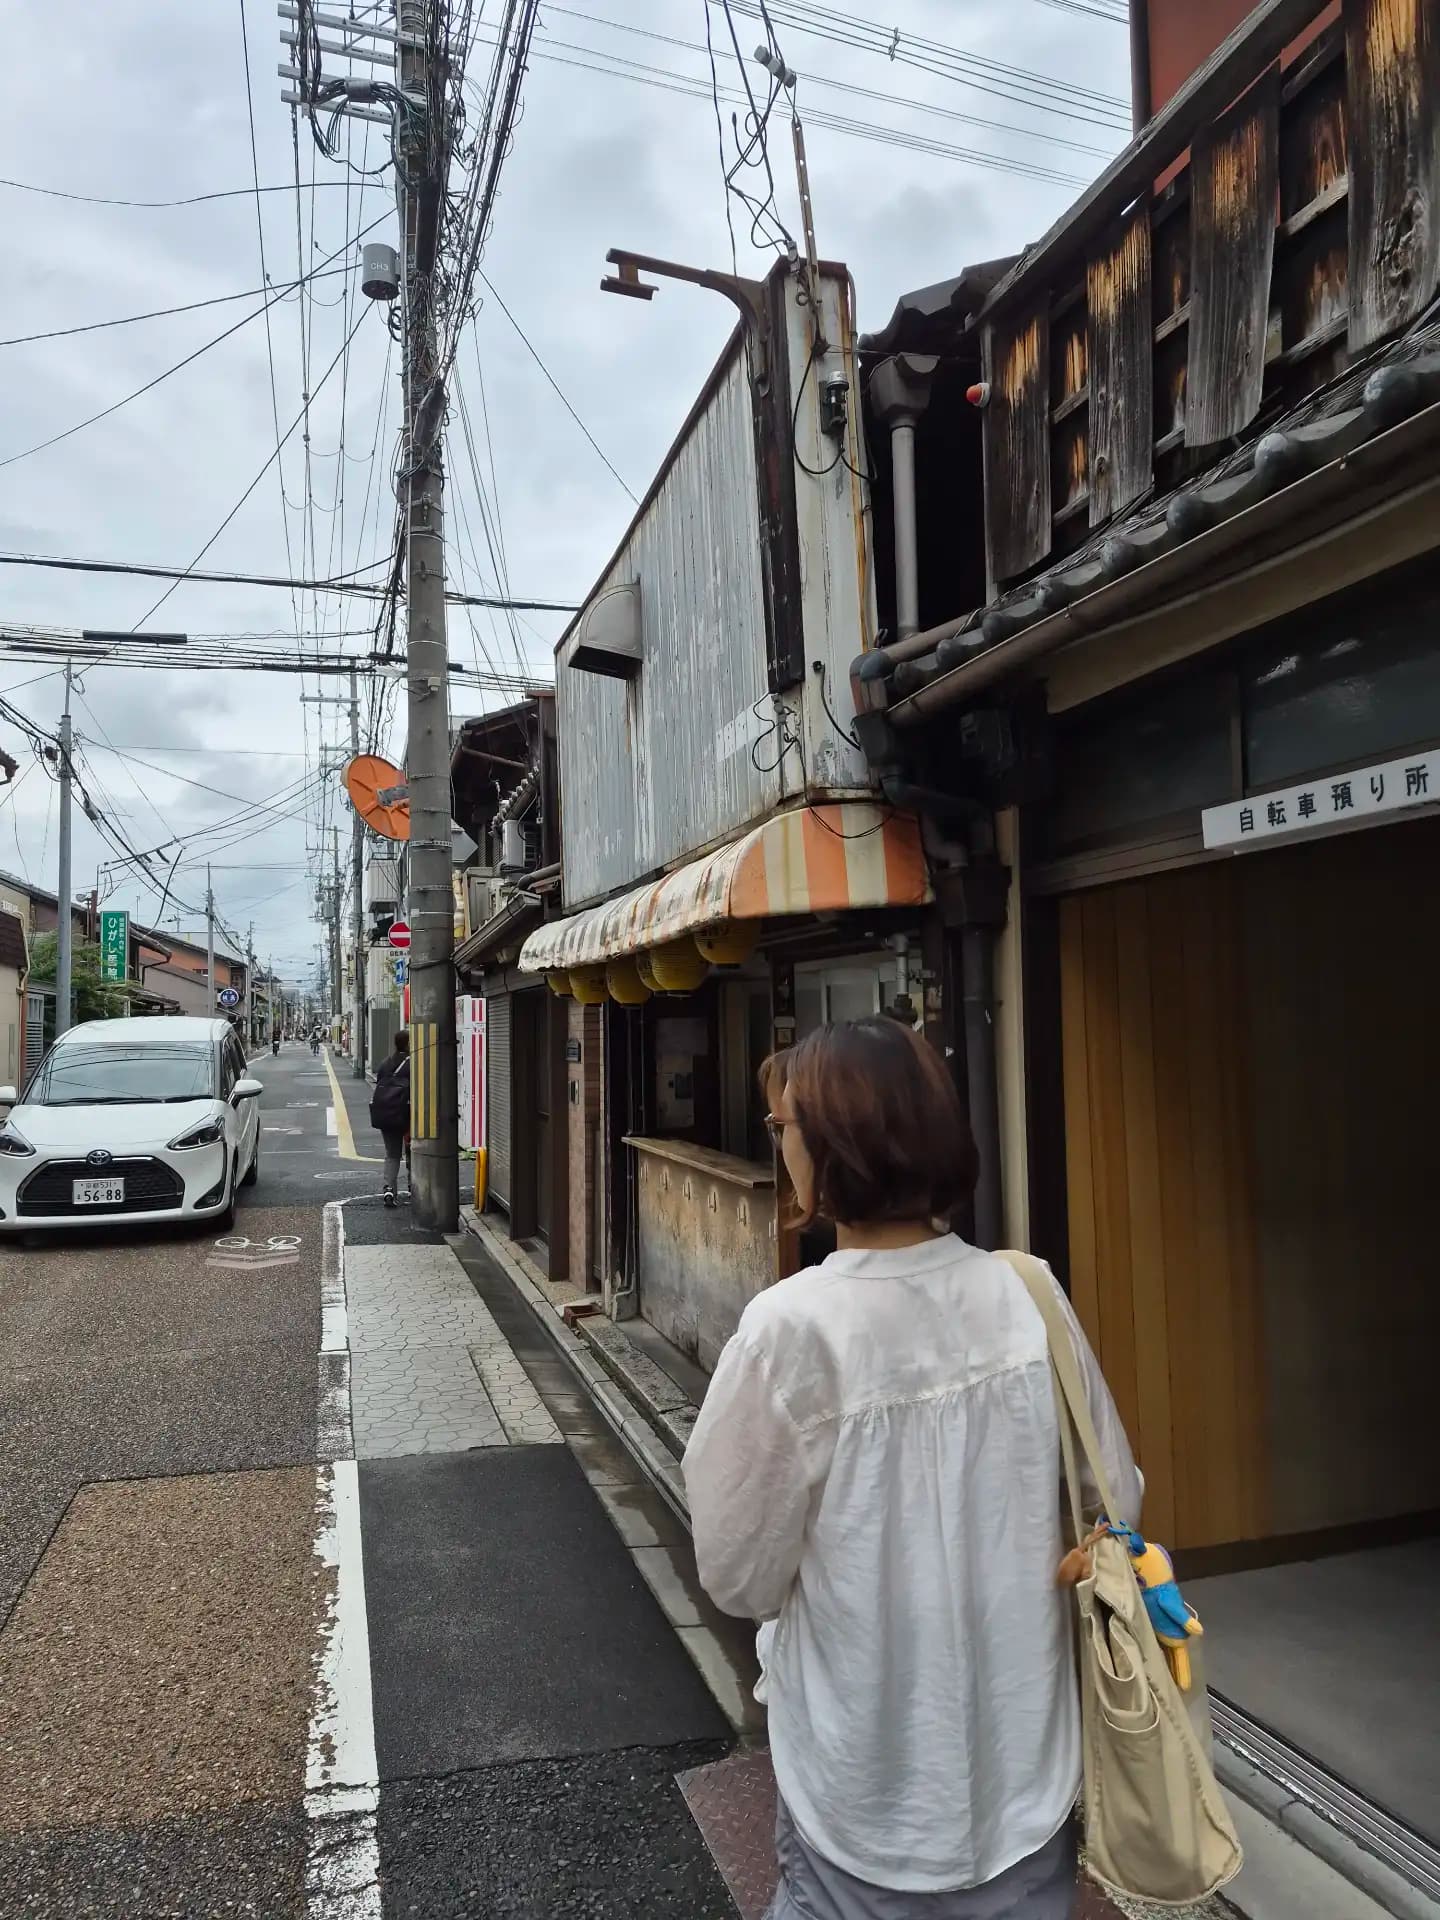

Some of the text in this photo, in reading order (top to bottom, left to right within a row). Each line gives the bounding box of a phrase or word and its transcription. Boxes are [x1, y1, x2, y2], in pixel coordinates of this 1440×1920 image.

[1239, 763, 1429, 834] 自転車預り所
[84, 1189, 122, 1201] 56-88
